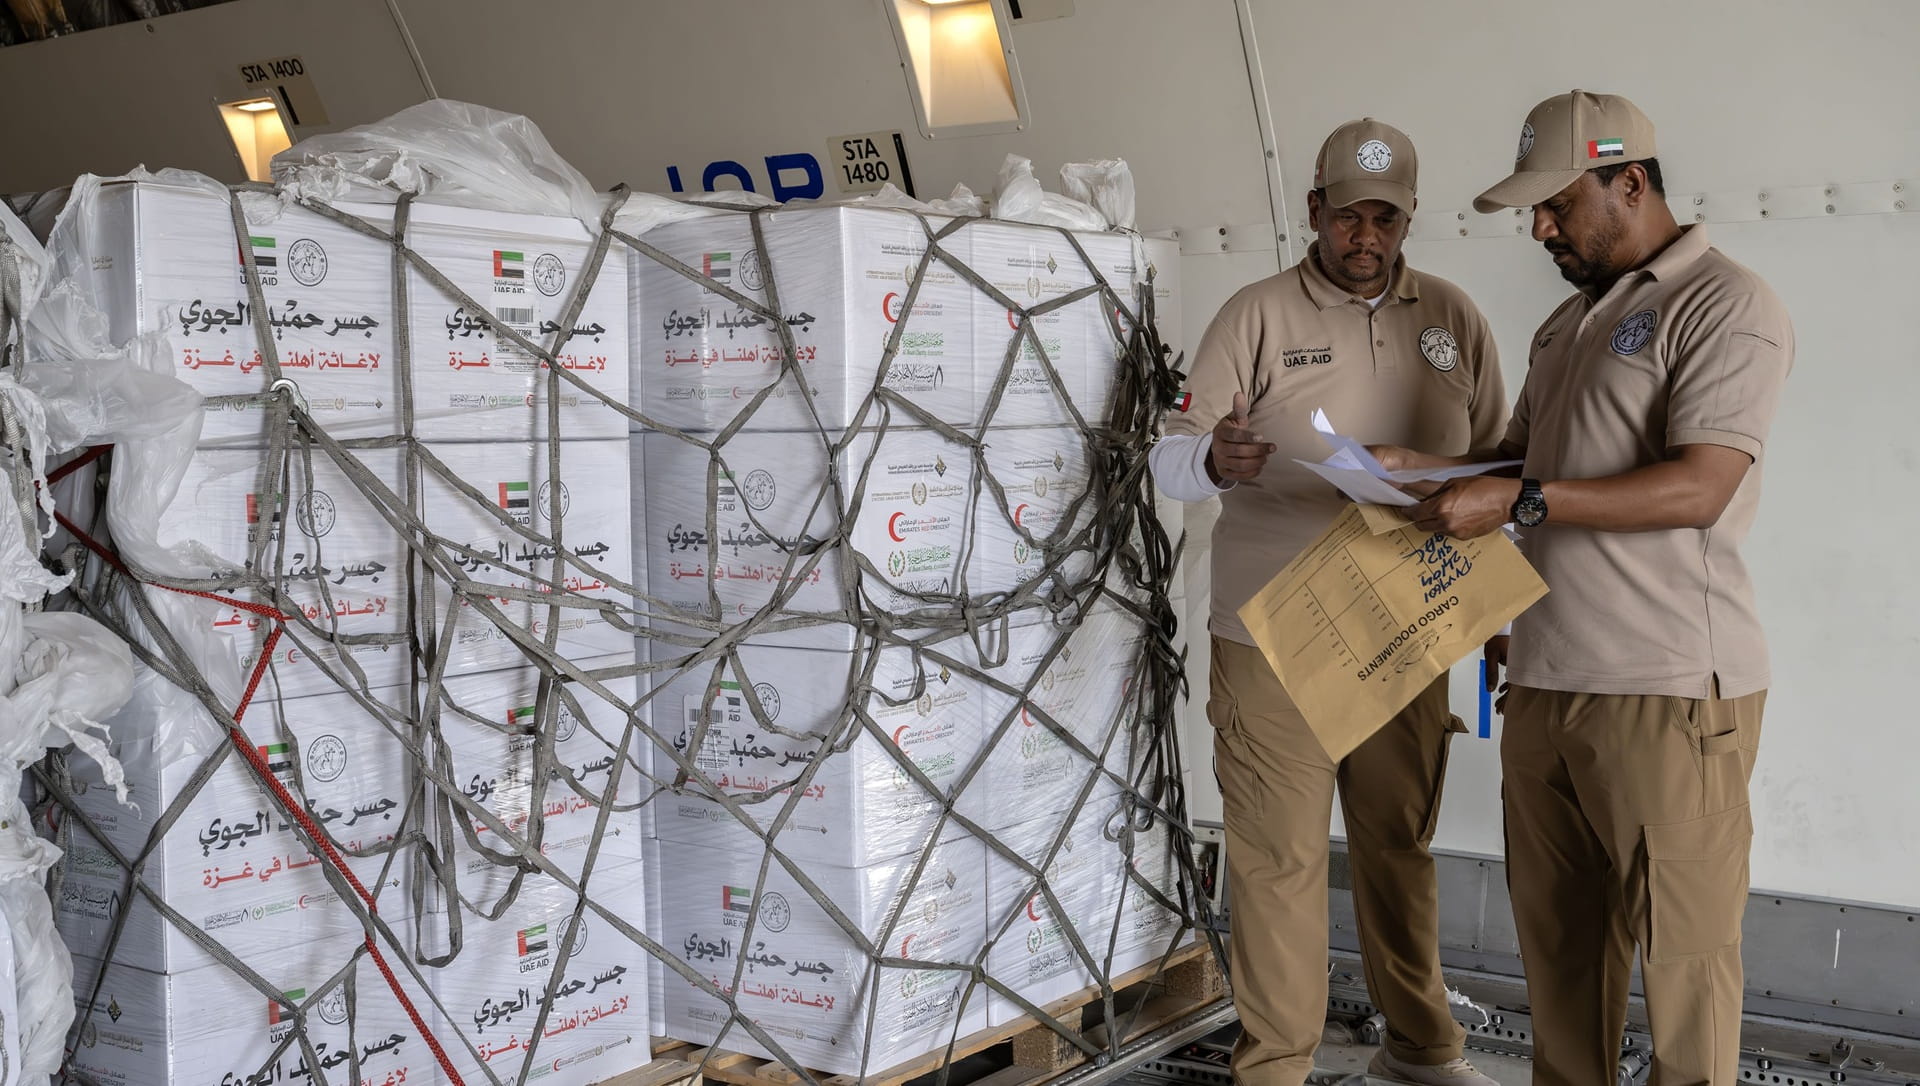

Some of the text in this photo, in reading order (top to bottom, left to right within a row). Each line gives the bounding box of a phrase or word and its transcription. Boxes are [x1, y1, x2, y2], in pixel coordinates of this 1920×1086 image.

[242, 58, 304, 83] STA 1400
[842, 138, 880, 160] STA
[842, 161, 890, 184] 1480
[324, 314, 380, 338] جسر
[663, 308, 710, 340] الجوي
[183, 348, 235, 370] غزة
[240, 350, 263, 374] في
[449, 352, 490, 370] غزة
[665, 350, 698, 367] غزة
[702, 348, 718, 368] في
[722, 345, 759, 363] أهلنا
[1284, 354, 1332, 368] UAE AID
[517, 516, 530, 525] AID
[331, 561, 387, 585] جسر
[670, 562, 704, 580] غزة
[728, 563, 764, 581] أهلنا
[1418, 596, 1460, 627] CARGO
[1358, 623, 1418, 681] DOCUMENTS
[728, 714, 741, 722] AID
[732, 775, 768, 792] أهلنا
[343, 798, 398, 826] جسر
[199, 810, 270, 858] الجوي
[203, 861, 254, 888] غزة
[259, 856, 282, 883] في
[724, 918, 737, 927] UAE
[684, 933, 731, 962] الجوي
[520, 958, 550, 973] UAE AID
[786, 960, 834, 982] جسر
[586, 964, 627, 994] جسر
[743, 980, 778, 999] أهلنا
[474, 988, 530, 1034] الجوي
[582, 995, 629, 1026] لإغاثة
[782, 988, 835, 1012] لإغاثة
[543, 1010, 580, 1038] أهلنا
[359, 1034, 406, 1066] جسر
[479, 1036, 518, 1062] غزة
